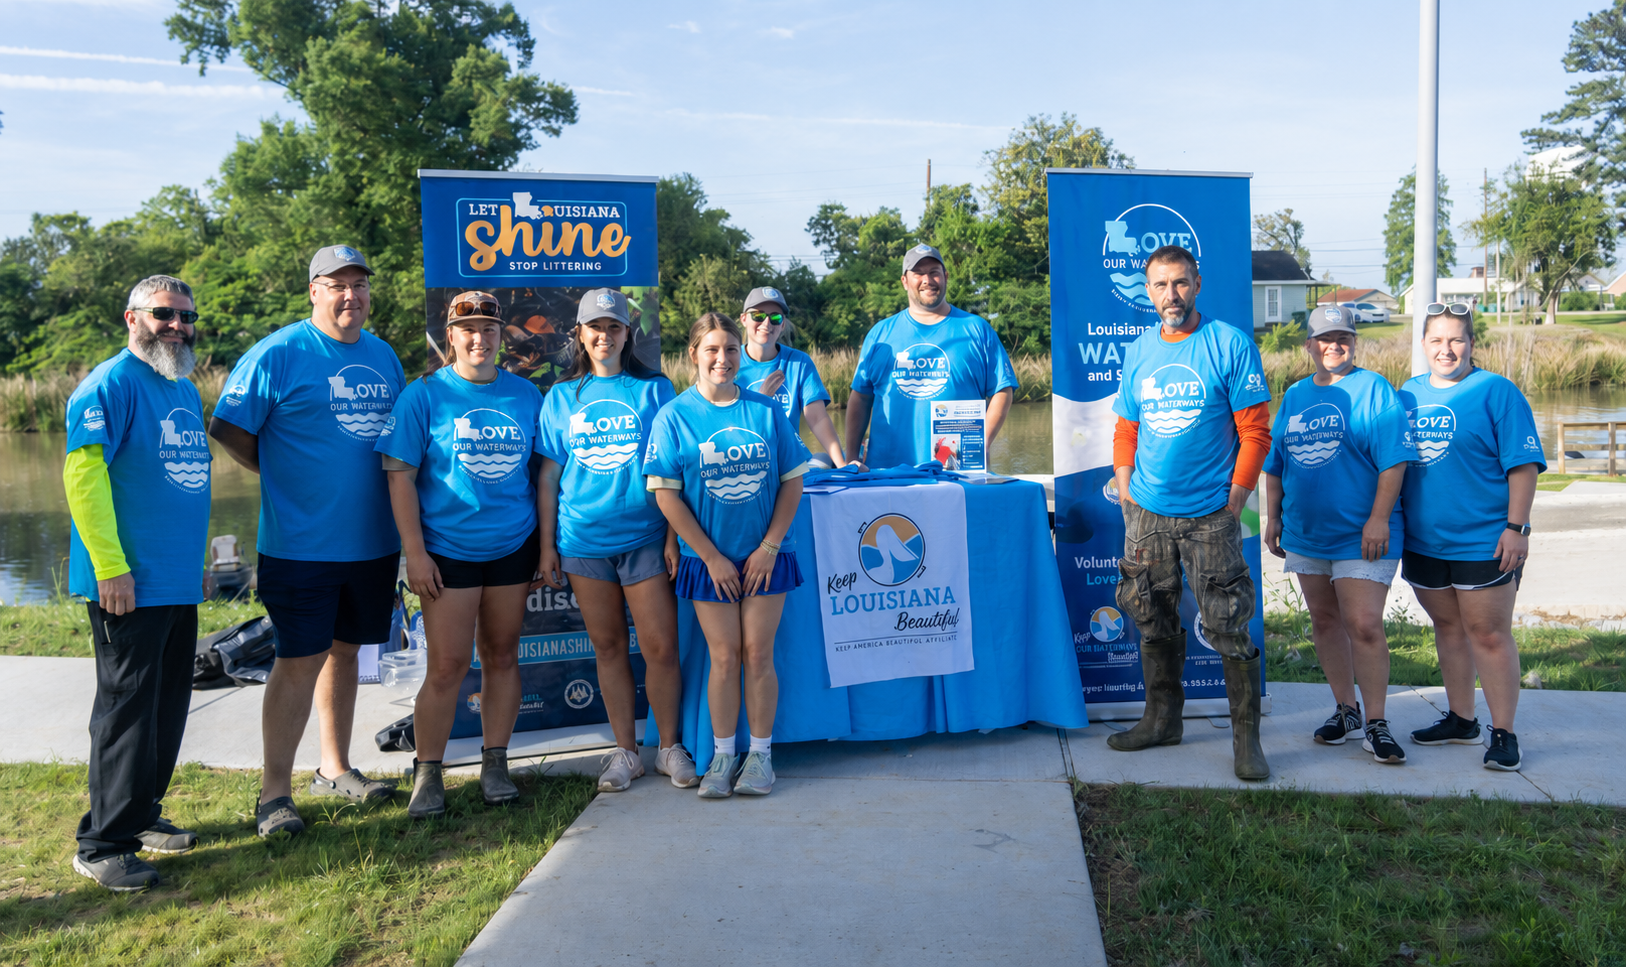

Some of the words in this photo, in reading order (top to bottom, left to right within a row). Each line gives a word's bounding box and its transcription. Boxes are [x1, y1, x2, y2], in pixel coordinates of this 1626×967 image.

[469, 204, 498, 215] LET
[464, 205, 632, 271] shine
[509, 262, 538, 270] STOP
[543, 262, 602, 270] LITTERING
[1103, 259, 1126, 269] OUR
[1088, 370, 1112, 381] and
[330, 402, 349, 411] OUR
[1141, 401, 1154, 411] OUR
[588, 433, 642, 444] WATERWAYS
[452, 443, 472, 451] OUR
[475, 443, 527, 452] WATERWAYS
[159, 450, 177, 459] OUR
[700, 468, 718, 478] OUR
[827, 571, 857, 594] Keep
[830, 586, 956, 616] LOUISIANA
[894, 607, 960, 632] Beautiful
[835, 644, 851, 652] KEEP
[853, 642, 884, 650] AMERICA
[886, 638, 923, 646] BEAUTIFUL
